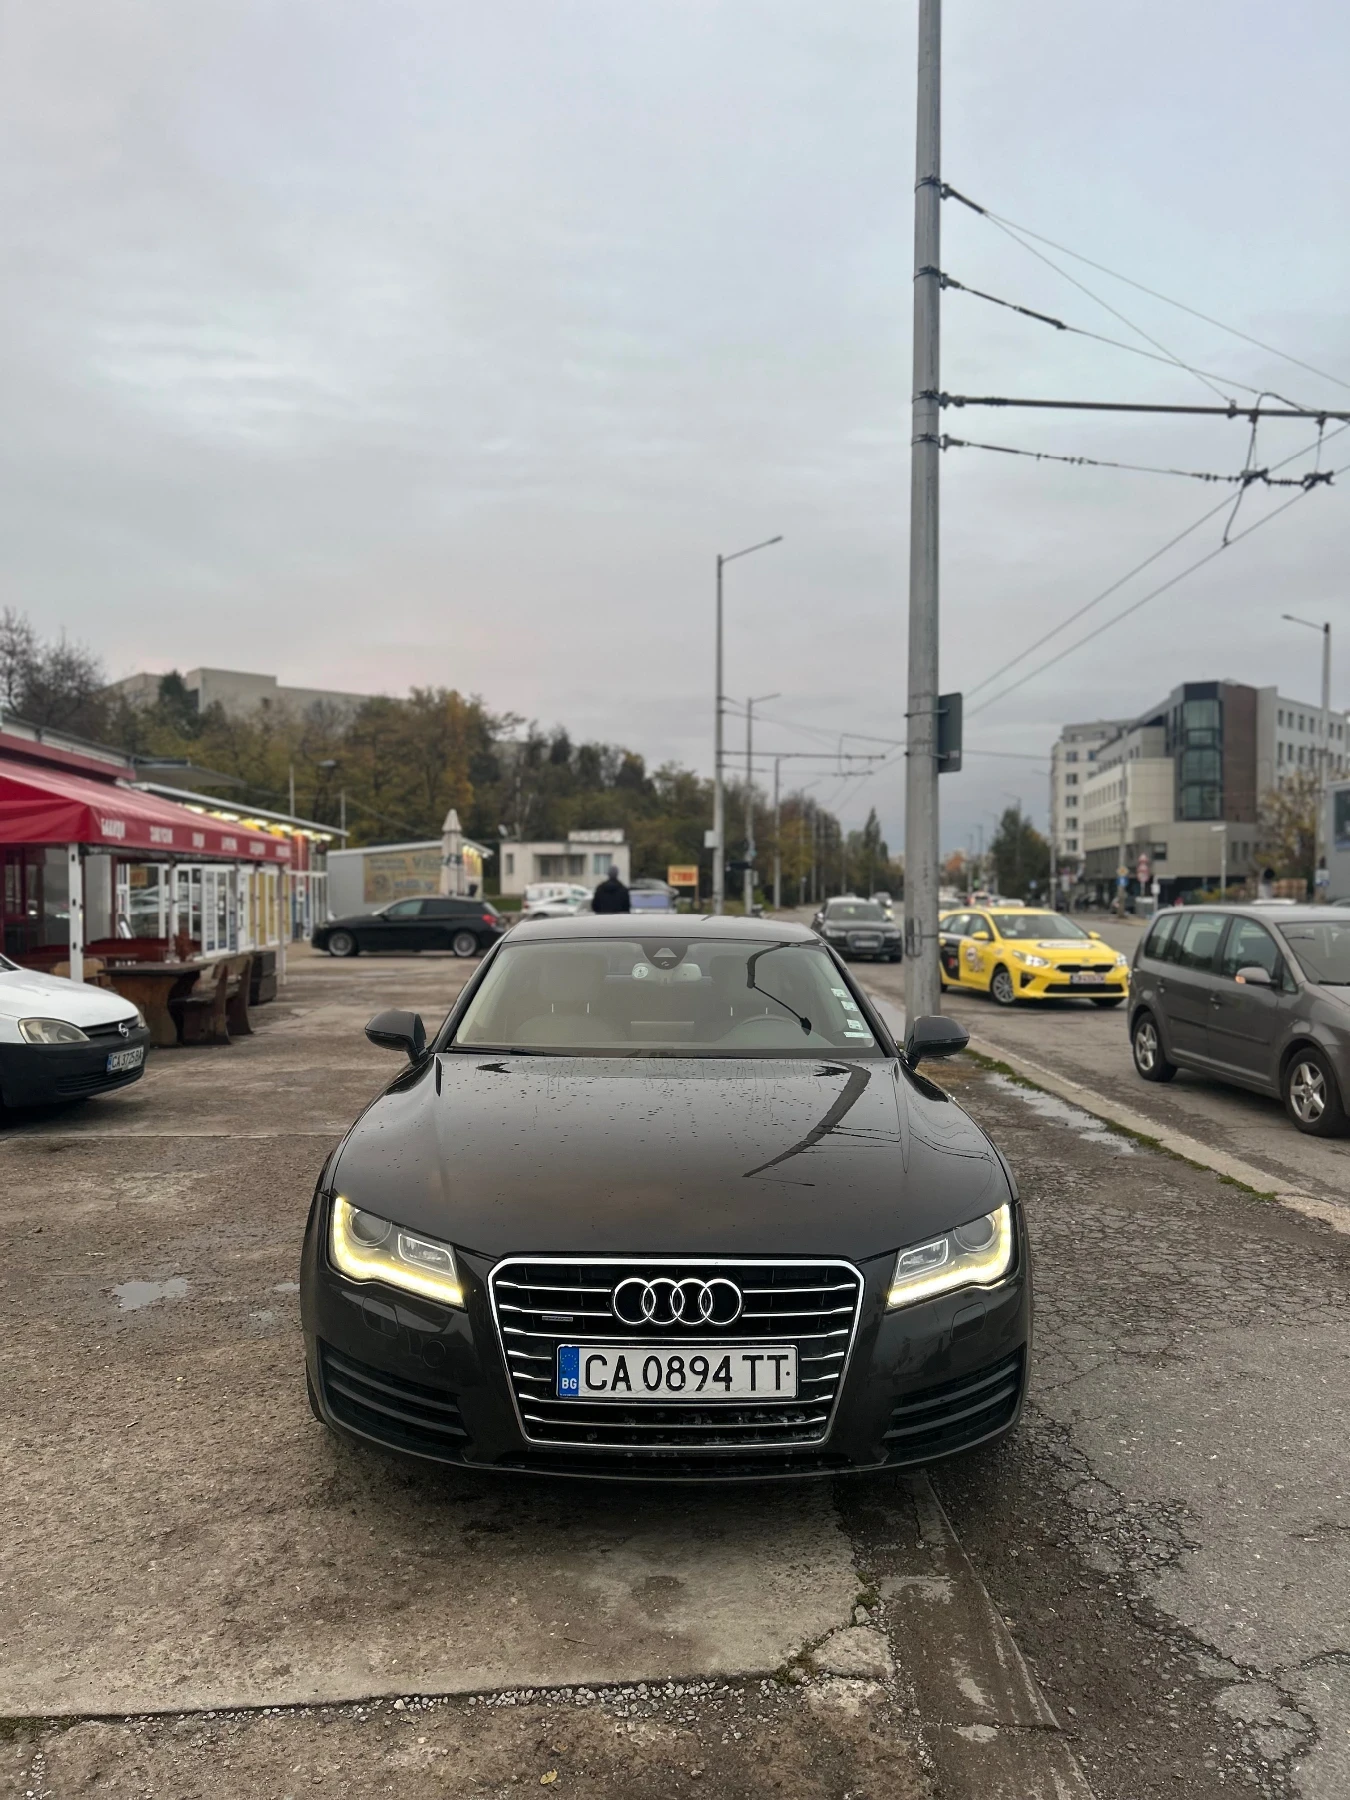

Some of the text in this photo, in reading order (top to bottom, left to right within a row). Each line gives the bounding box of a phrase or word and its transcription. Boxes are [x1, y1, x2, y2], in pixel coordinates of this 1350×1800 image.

[112, 1055, 121, 1068] CA
[585, 1354, 789, 1391] CA 0894 TT
[561, 1377, 578, 1390] BG
